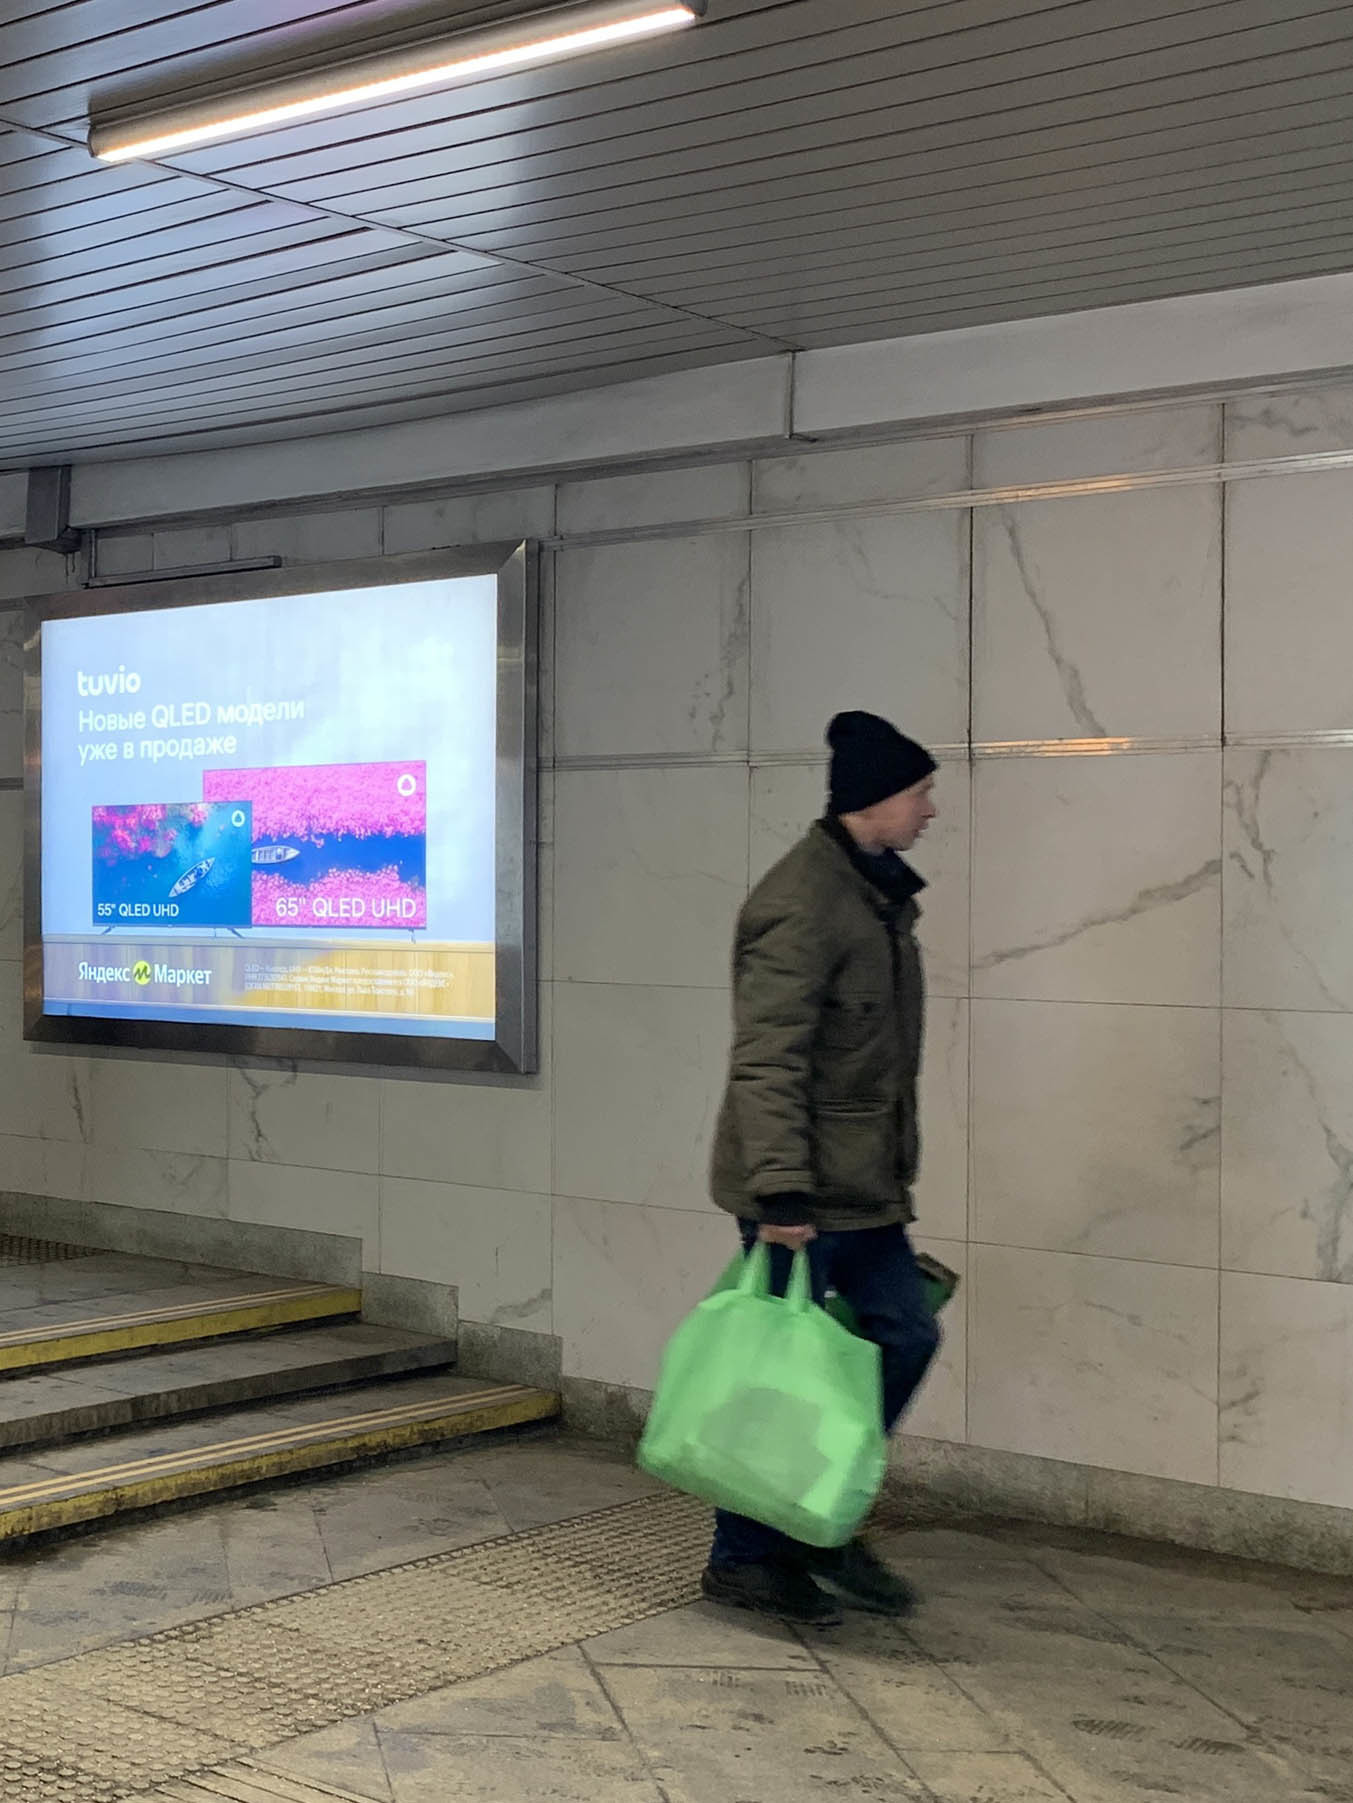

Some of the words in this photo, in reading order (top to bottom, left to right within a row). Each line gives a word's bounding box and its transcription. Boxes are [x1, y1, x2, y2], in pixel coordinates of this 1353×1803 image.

[77, 664, 142, 697] tuvio
[78, 710, 146, 732] Новые
[151, 701, 211, 729] QLED
[216, 701, 305, 726] модели
[78, 742, 118, 766] уже
[123, 742, 134, 759] в
[139, 734, 237, 763] продаже
[119, 903, 151, 917] QLED
[153, 904, 180, 917] UHD
[312, 898, 365, 917] QLED
[372, 898, 417, 918] UHD
[79, 962, 130, 984] Яндекс
[154, 964, 212, 987] Маркет
